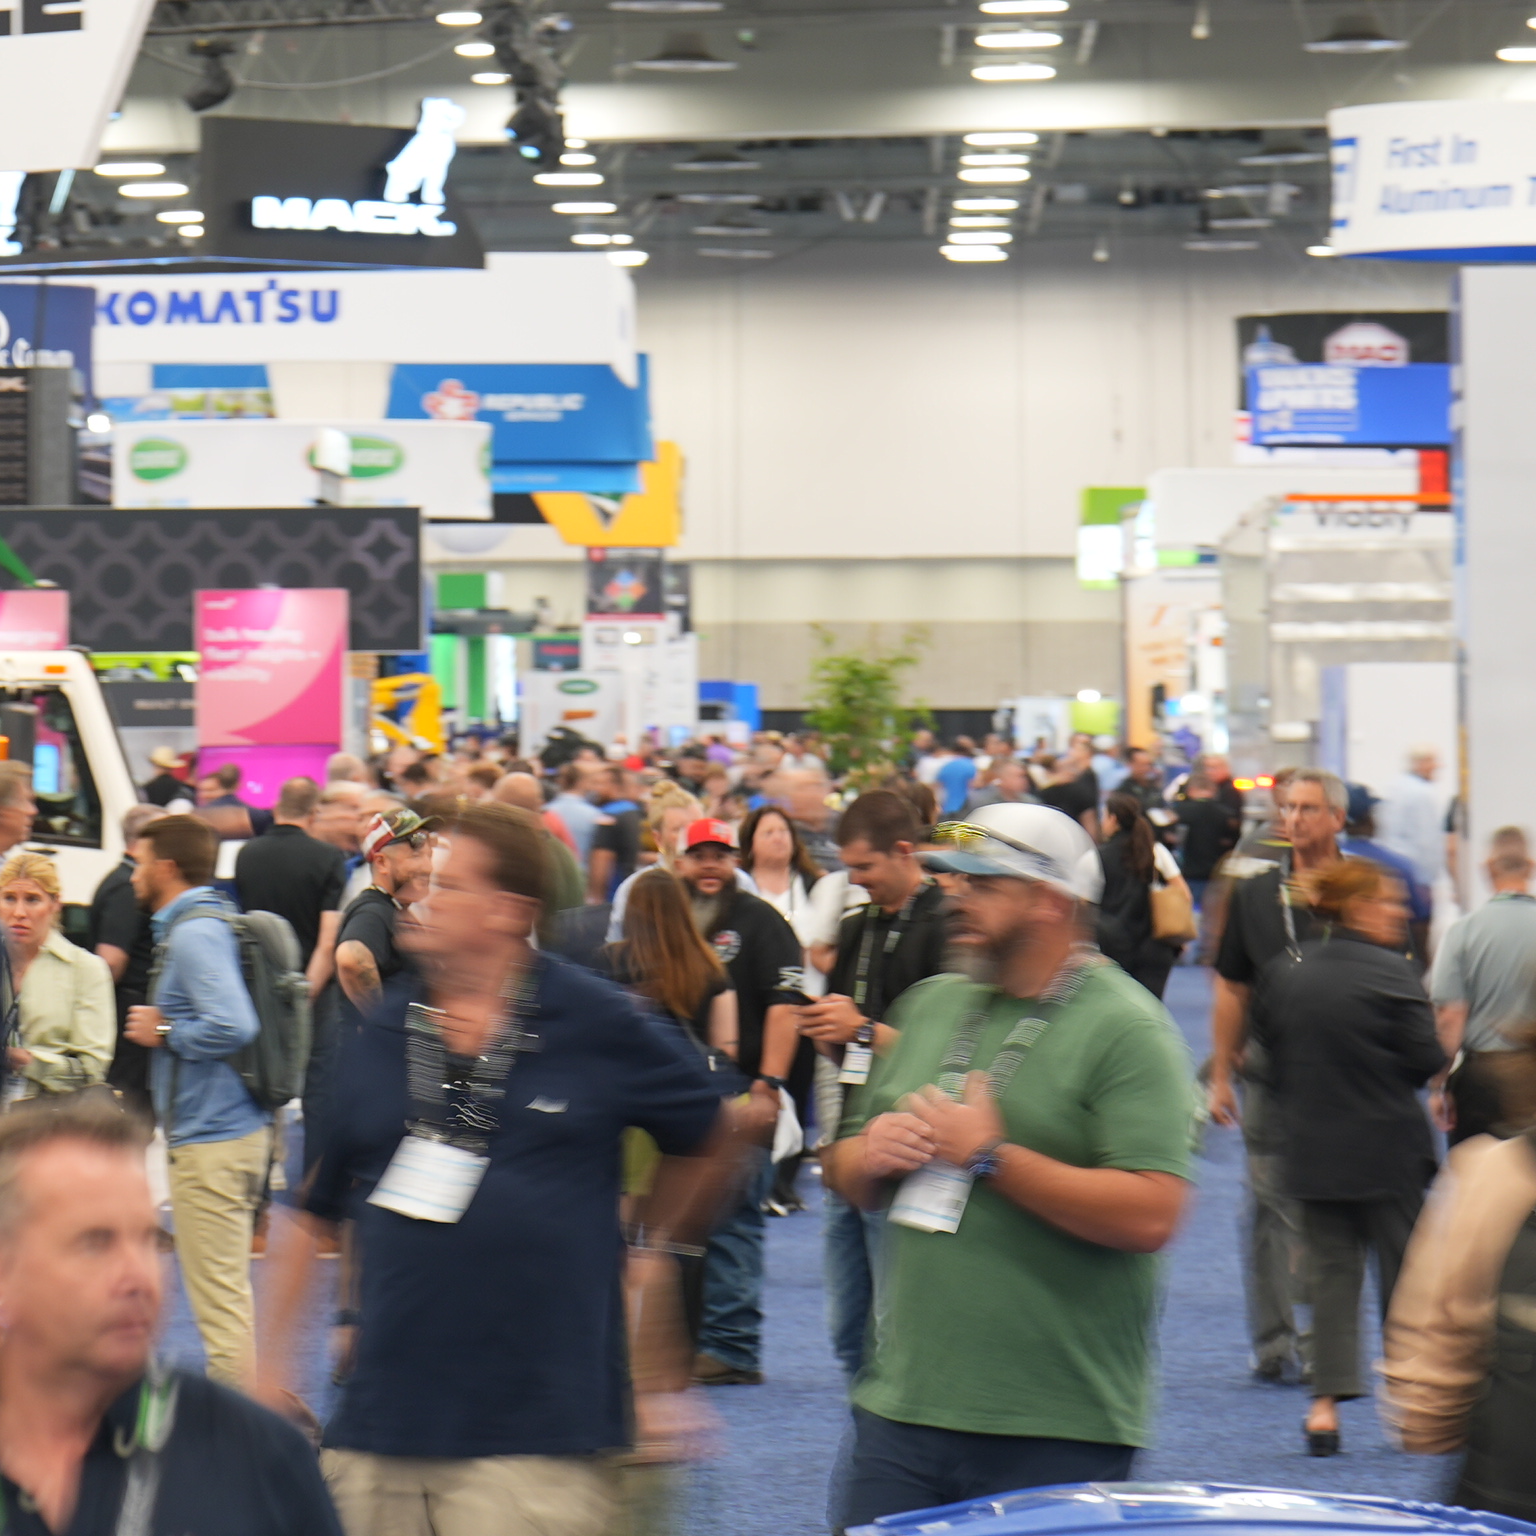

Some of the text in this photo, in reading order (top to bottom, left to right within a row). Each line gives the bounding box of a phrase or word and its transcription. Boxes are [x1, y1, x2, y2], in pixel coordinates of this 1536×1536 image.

[1386, 135, 1442, 167] First
[252, 195, 446, 235] MACK
[1380, 181, 1512, 214] Aluminum
[94, 278, 339, 325] KOMATSU
